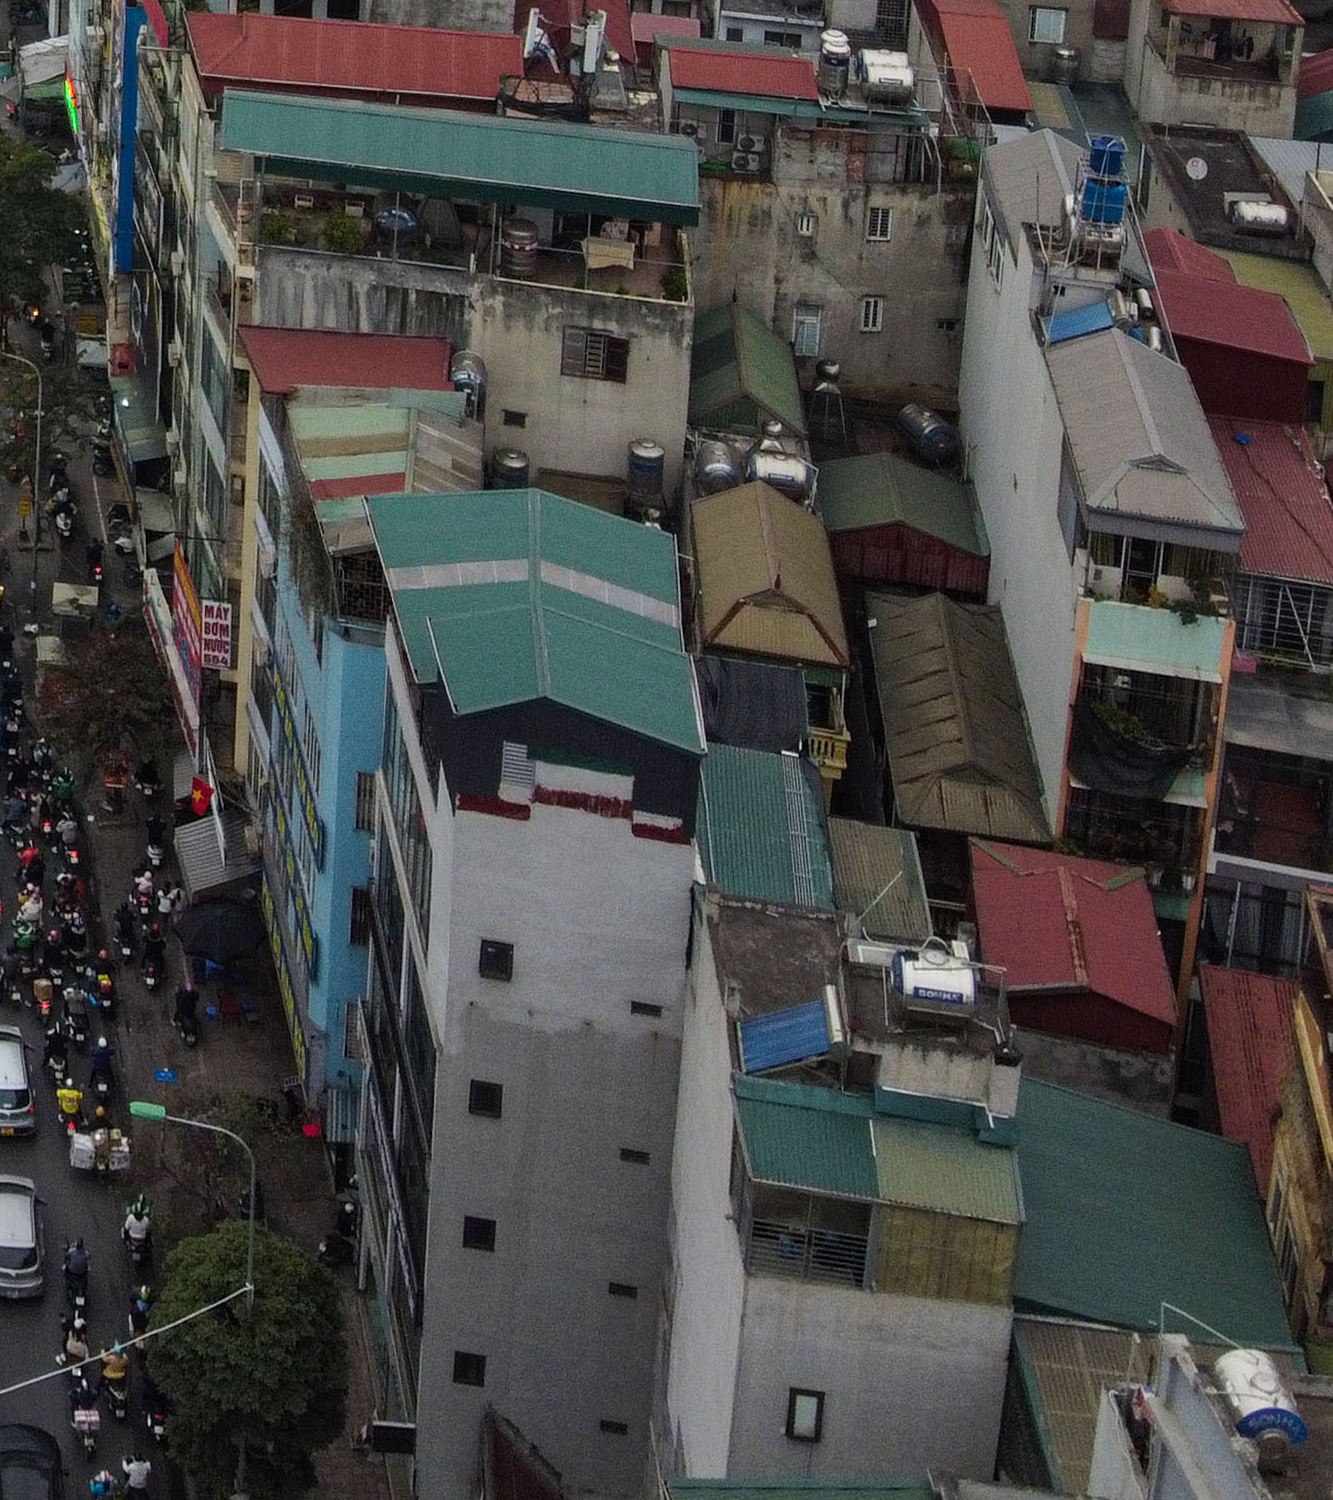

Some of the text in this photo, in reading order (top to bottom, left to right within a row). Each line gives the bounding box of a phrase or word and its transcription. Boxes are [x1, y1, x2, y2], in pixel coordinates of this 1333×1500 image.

[204, 604, 230, 621] MÁY
[204, 622, 230, 638] BƠM
[203, 637, 230, 654] NƯỚC
